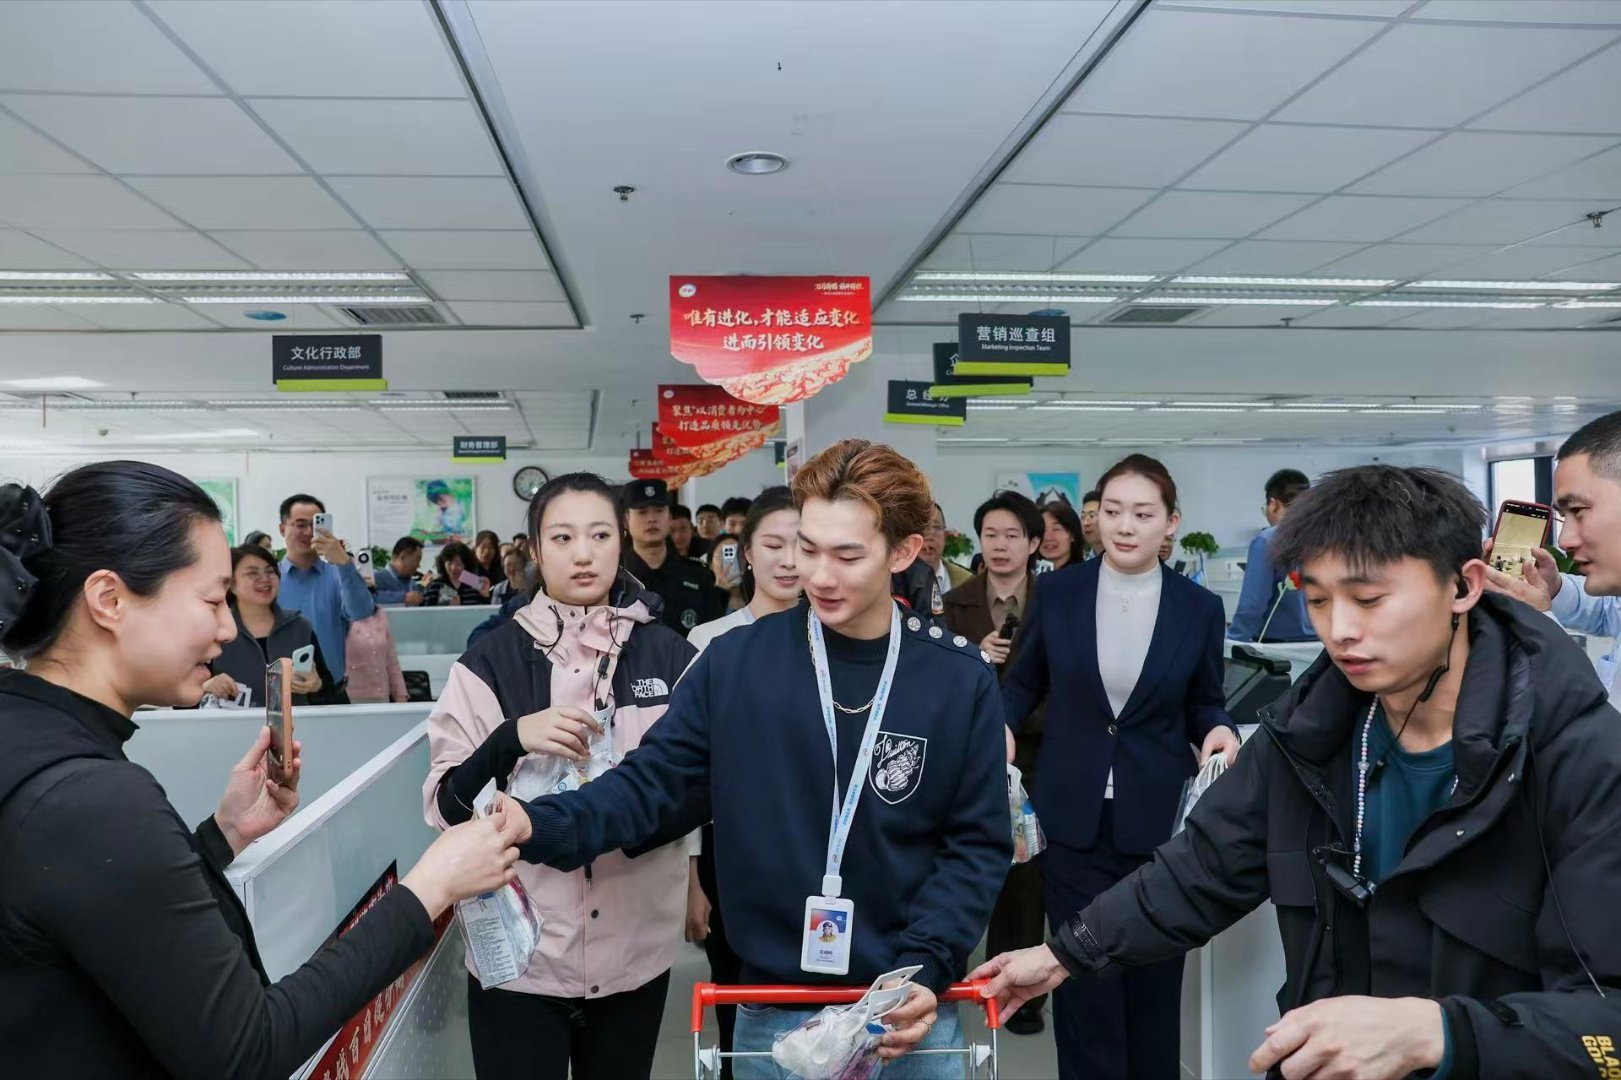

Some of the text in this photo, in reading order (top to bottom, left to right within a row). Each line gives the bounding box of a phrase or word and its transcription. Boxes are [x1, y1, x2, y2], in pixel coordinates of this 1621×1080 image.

[976, 325, 1056, 342] 营销巡查组
[723, 332, 825, 351] 进而引领变化
[1009, 344, 1036, 352] Inspection
[290, 346, 361, 360] 文化行政部
